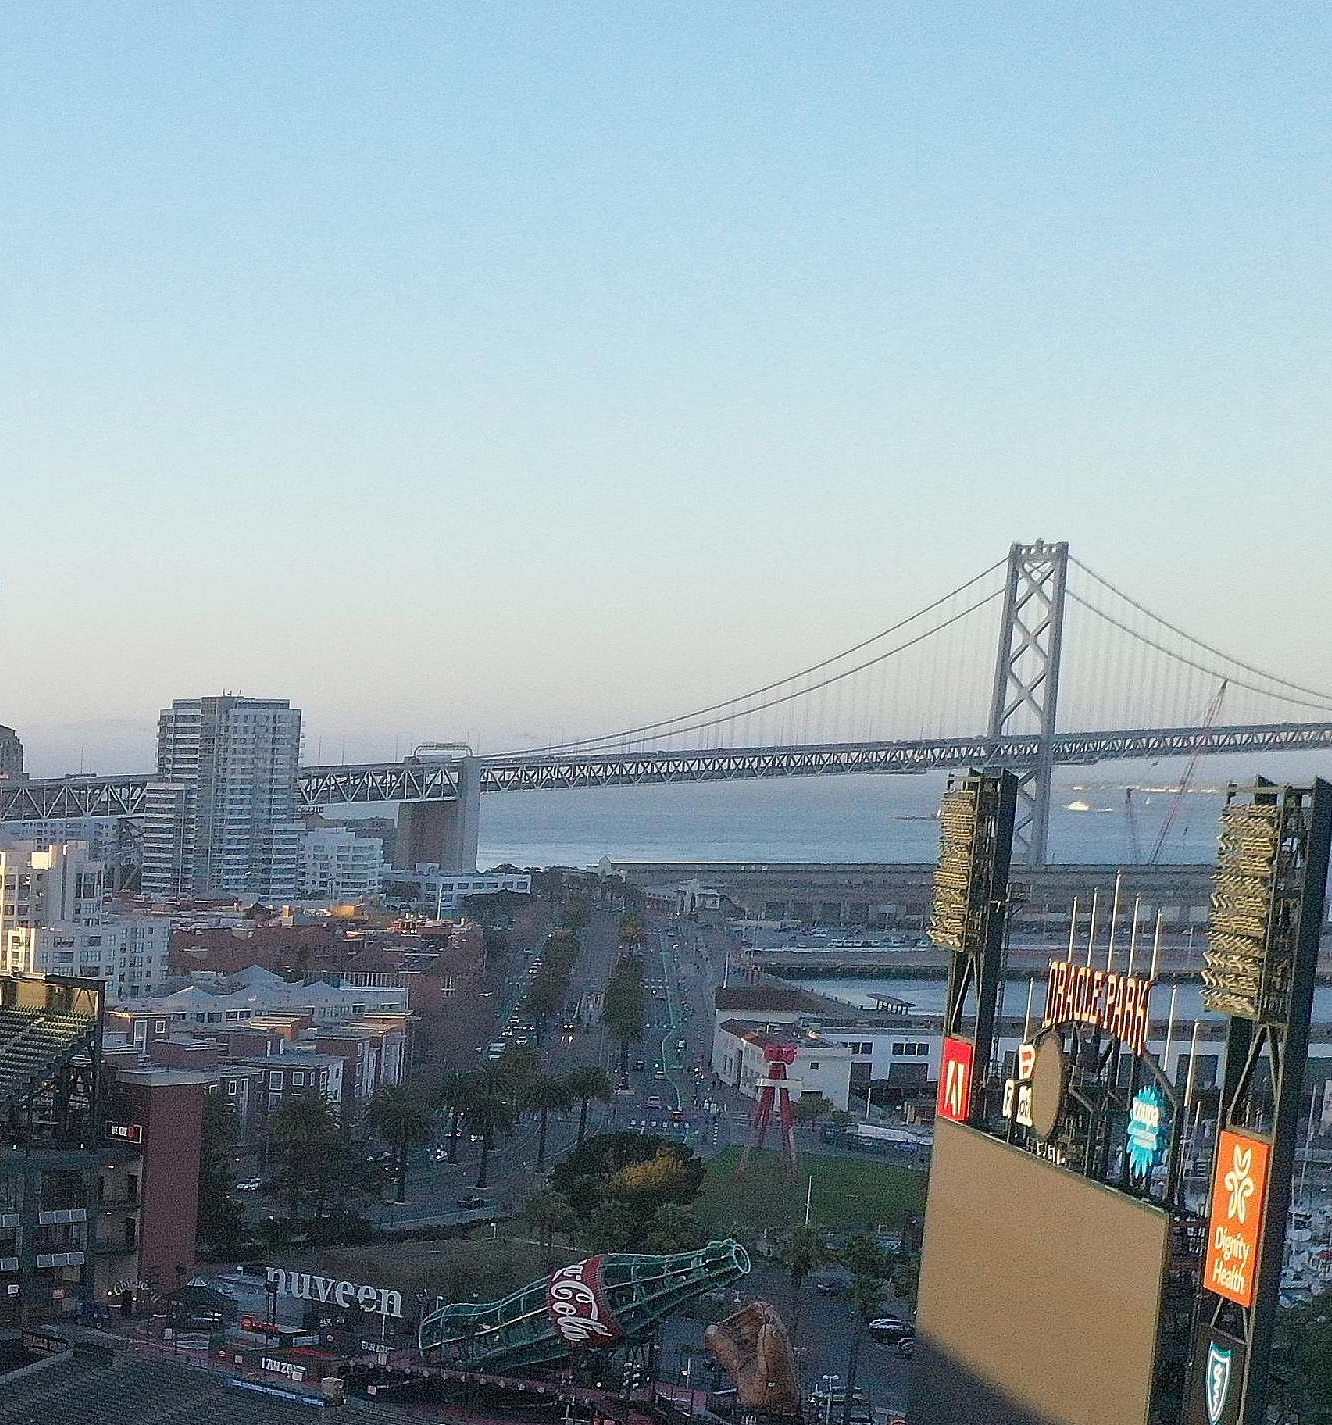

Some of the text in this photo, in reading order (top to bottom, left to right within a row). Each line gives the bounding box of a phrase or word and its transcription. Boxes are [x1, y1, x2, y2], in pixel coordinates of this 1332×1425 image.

[1042, 961, 1152, 1056] ORACLE PARK
[1215, 1226, 1250, 1269] Dignity
[266, 1267, 402, 1318] nuveen
[1212, 1258, 1245, 1295] Health
